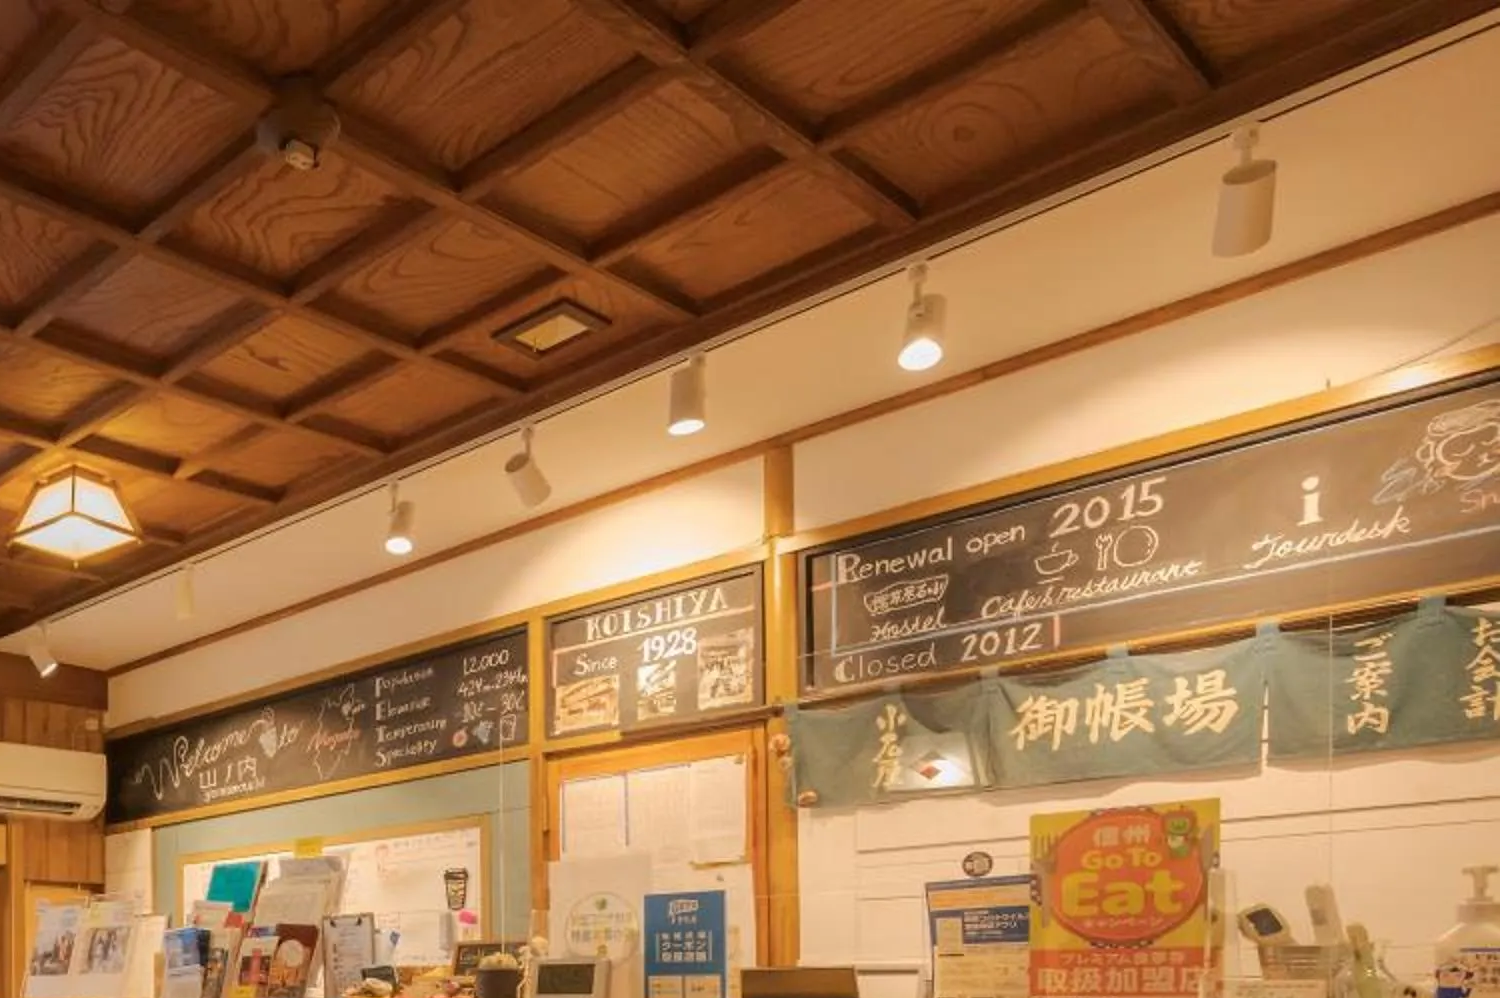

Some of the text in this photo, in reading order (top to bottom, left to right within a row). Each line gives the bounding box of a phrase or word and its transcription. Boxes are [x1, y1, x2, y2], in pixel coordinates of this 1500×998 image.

[835, 477, 1167, 584] Renewal open 2015
[585, 587, 729, 641] KOISHIYA
[573, 627, 698, 676] Since 1928
[834, 623, 1044, 684] Closed 2012
[1009, 669, 1240, 752] 御帳場
[133, 726, 252, 801] Welcome
[199, 755, 258, 789] 山ノ内
[1081, 846, 1164, 870] Go To
[1060, 869, 1186, 918] Eat
